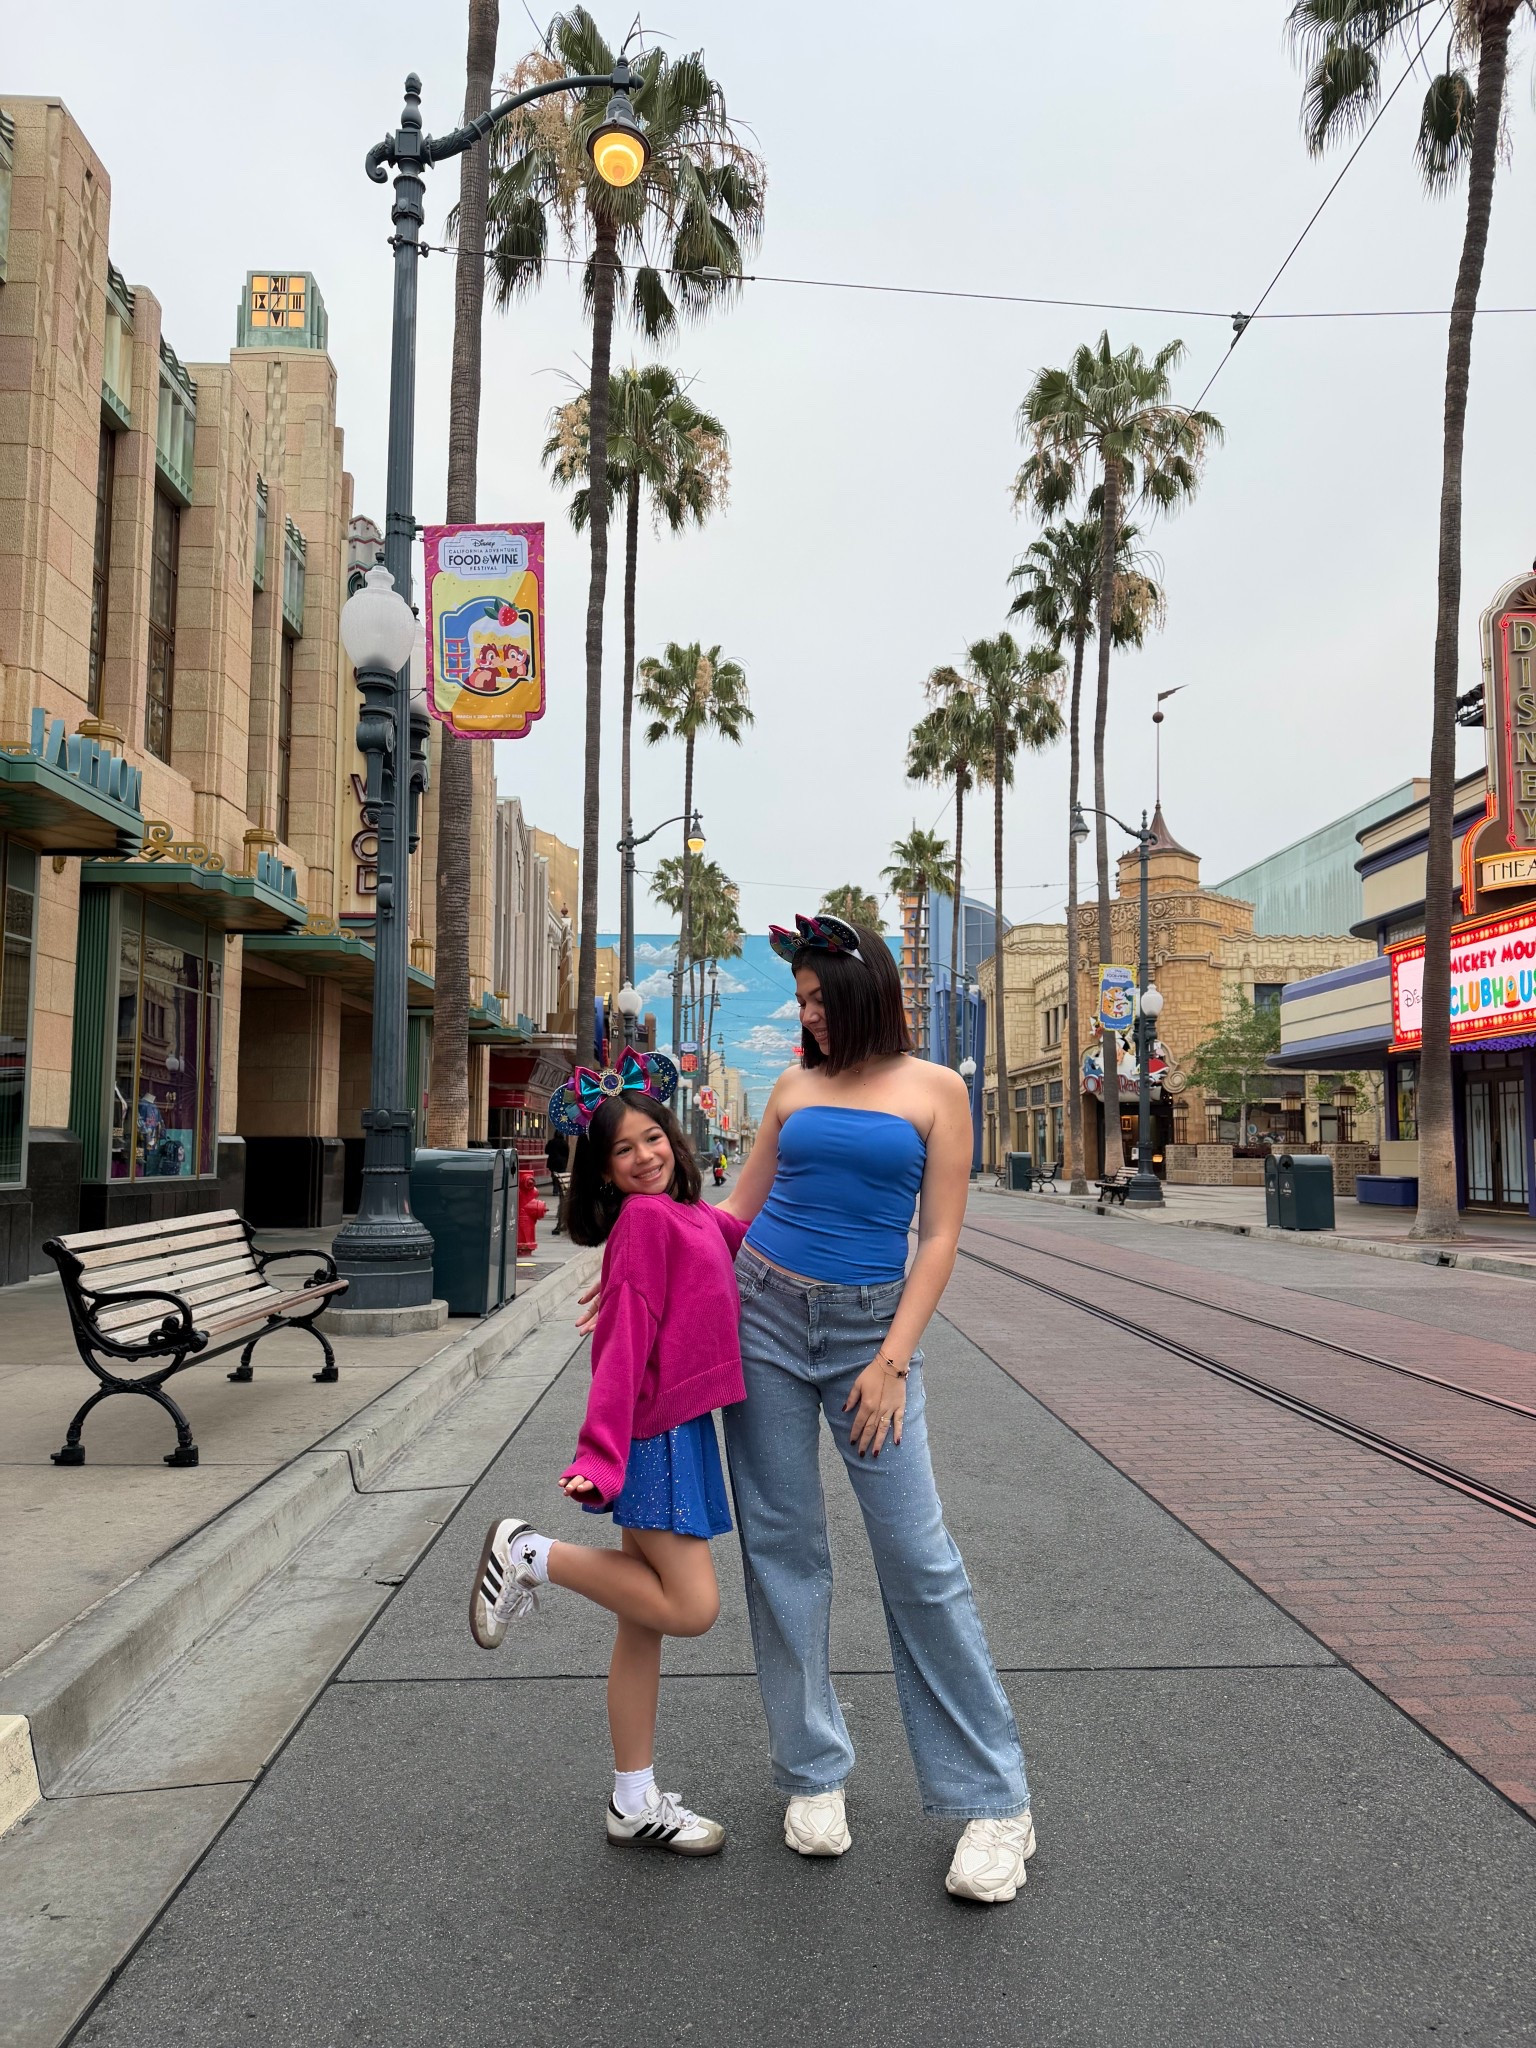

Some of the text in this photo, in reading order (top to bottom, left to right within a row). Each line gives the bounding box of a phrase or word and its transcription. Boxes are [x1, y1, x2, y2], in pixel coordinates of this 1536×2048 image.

[471, 539, 496, 548] Disney
[448, 554, 518, 566] FOOD & WINE
[30, 707, 143, 813] FASHION
[1450, 940, 1536, 974] MICKEY MOU
[1402, 988, 1422, 1008] Dis
[1450, 968, 1536, 1016] CLUBHOU
